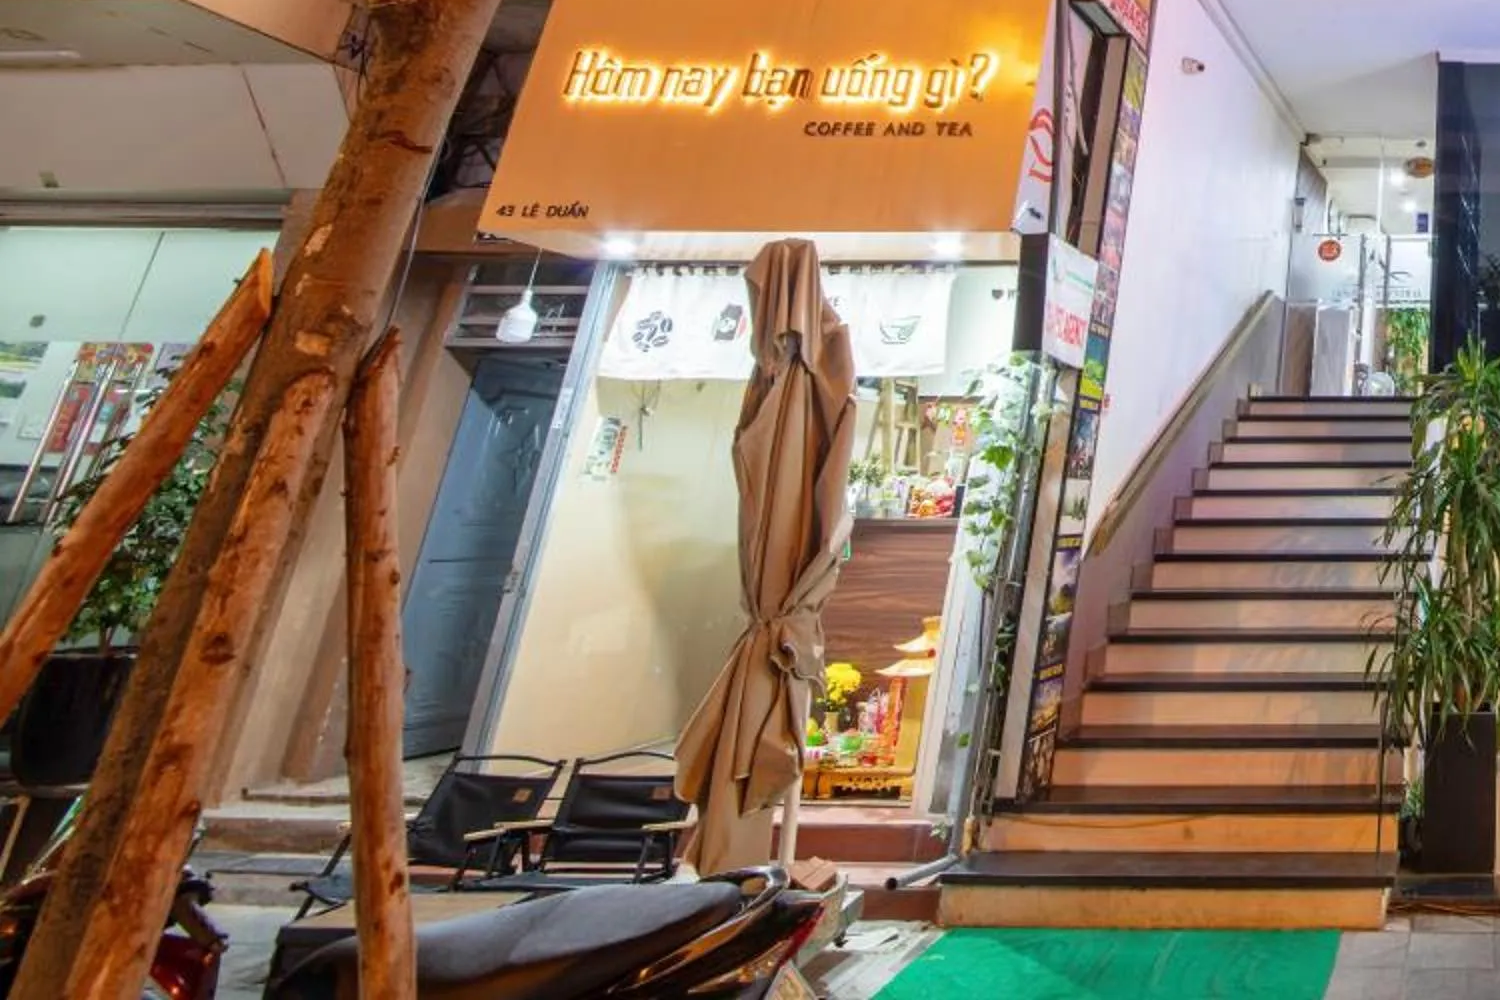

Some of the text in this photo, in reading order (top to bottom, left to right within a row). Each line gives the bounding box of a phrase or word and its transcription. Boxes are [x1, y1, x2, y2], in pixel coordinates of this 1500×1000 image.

[563, 51, 652, 98] Hôm
[660, 65, 731, 108] nay
[742, 51, 815, 106] bạn
[820, 53, 914, 108] uống
[804, 121, 973, 137] COFFEE AND TEA
[496, 204, 515, 217] 43
